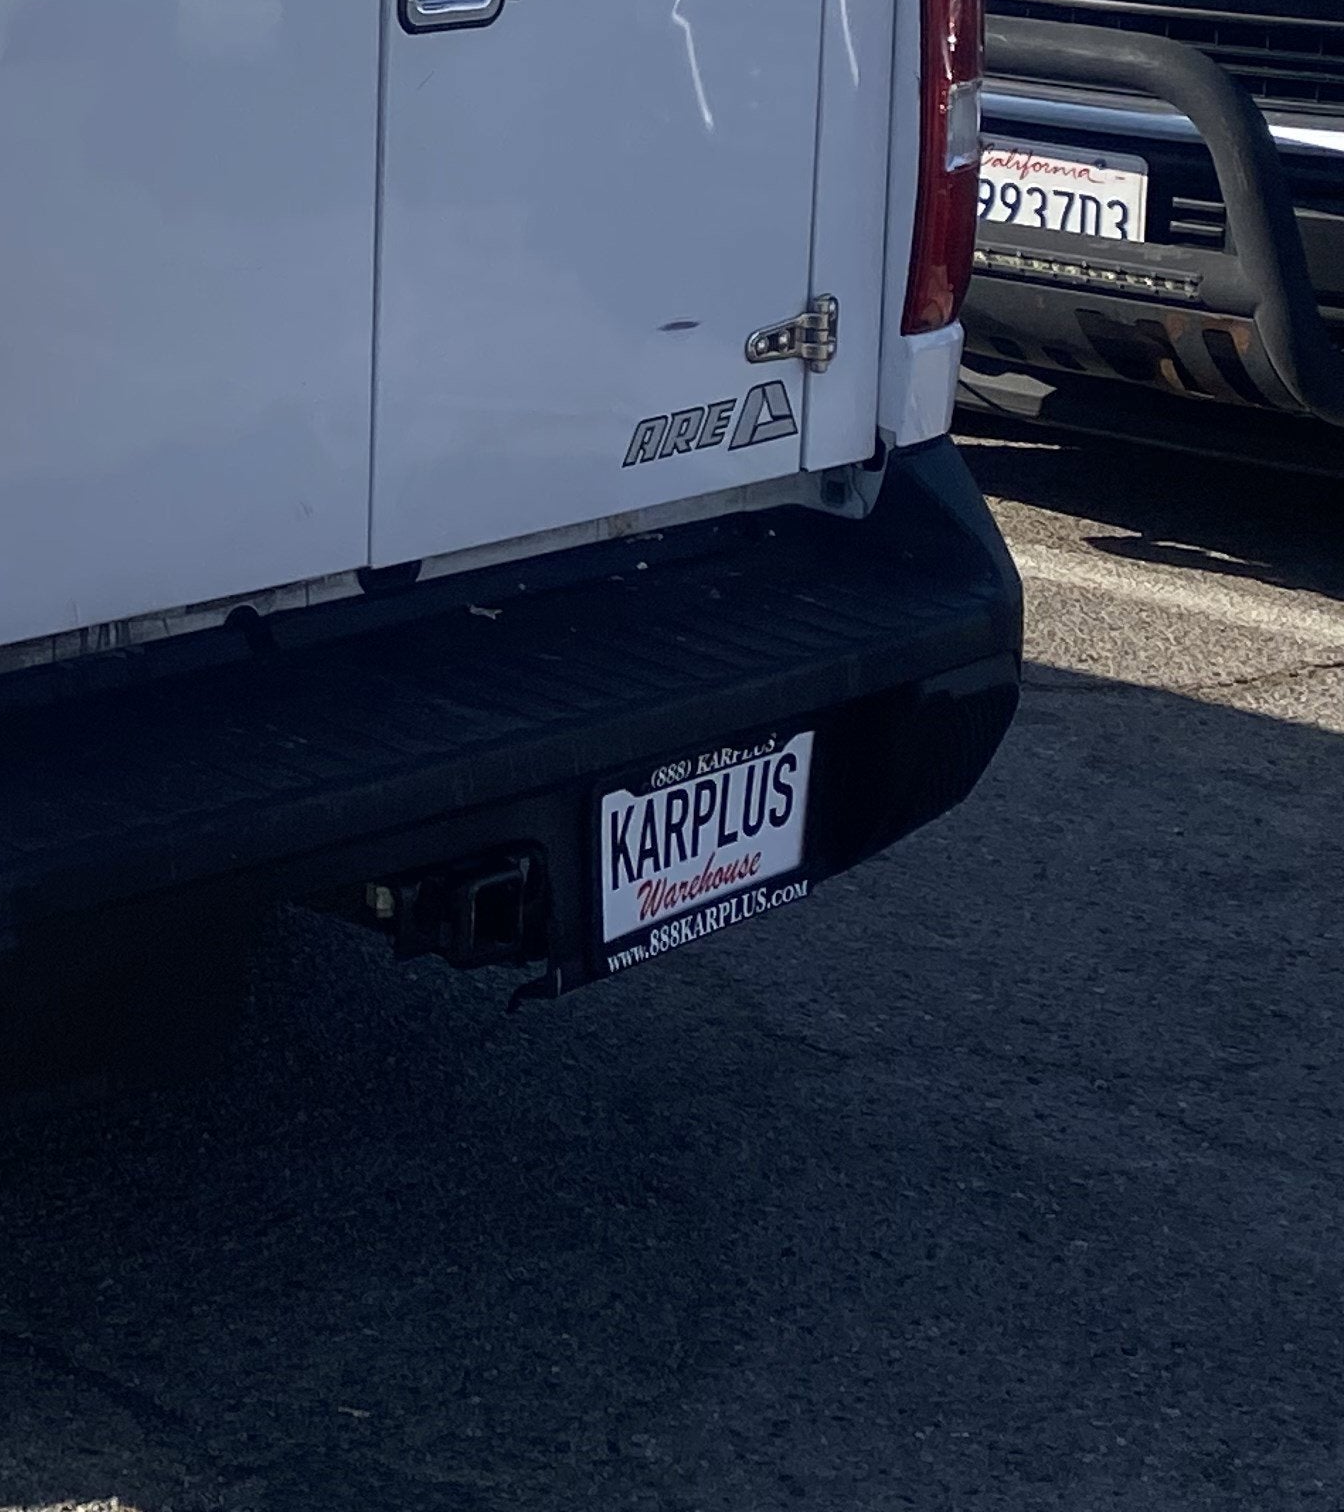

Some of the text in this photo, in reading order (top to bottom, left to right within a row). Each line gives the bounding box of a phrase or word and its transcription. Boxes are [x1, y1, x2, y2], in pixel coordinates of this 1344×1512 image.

[651, 759, 692, 788] (888)
[610, 752, 798, 892] KARPLUS
[636, 850, 762, 922] Warehouse
